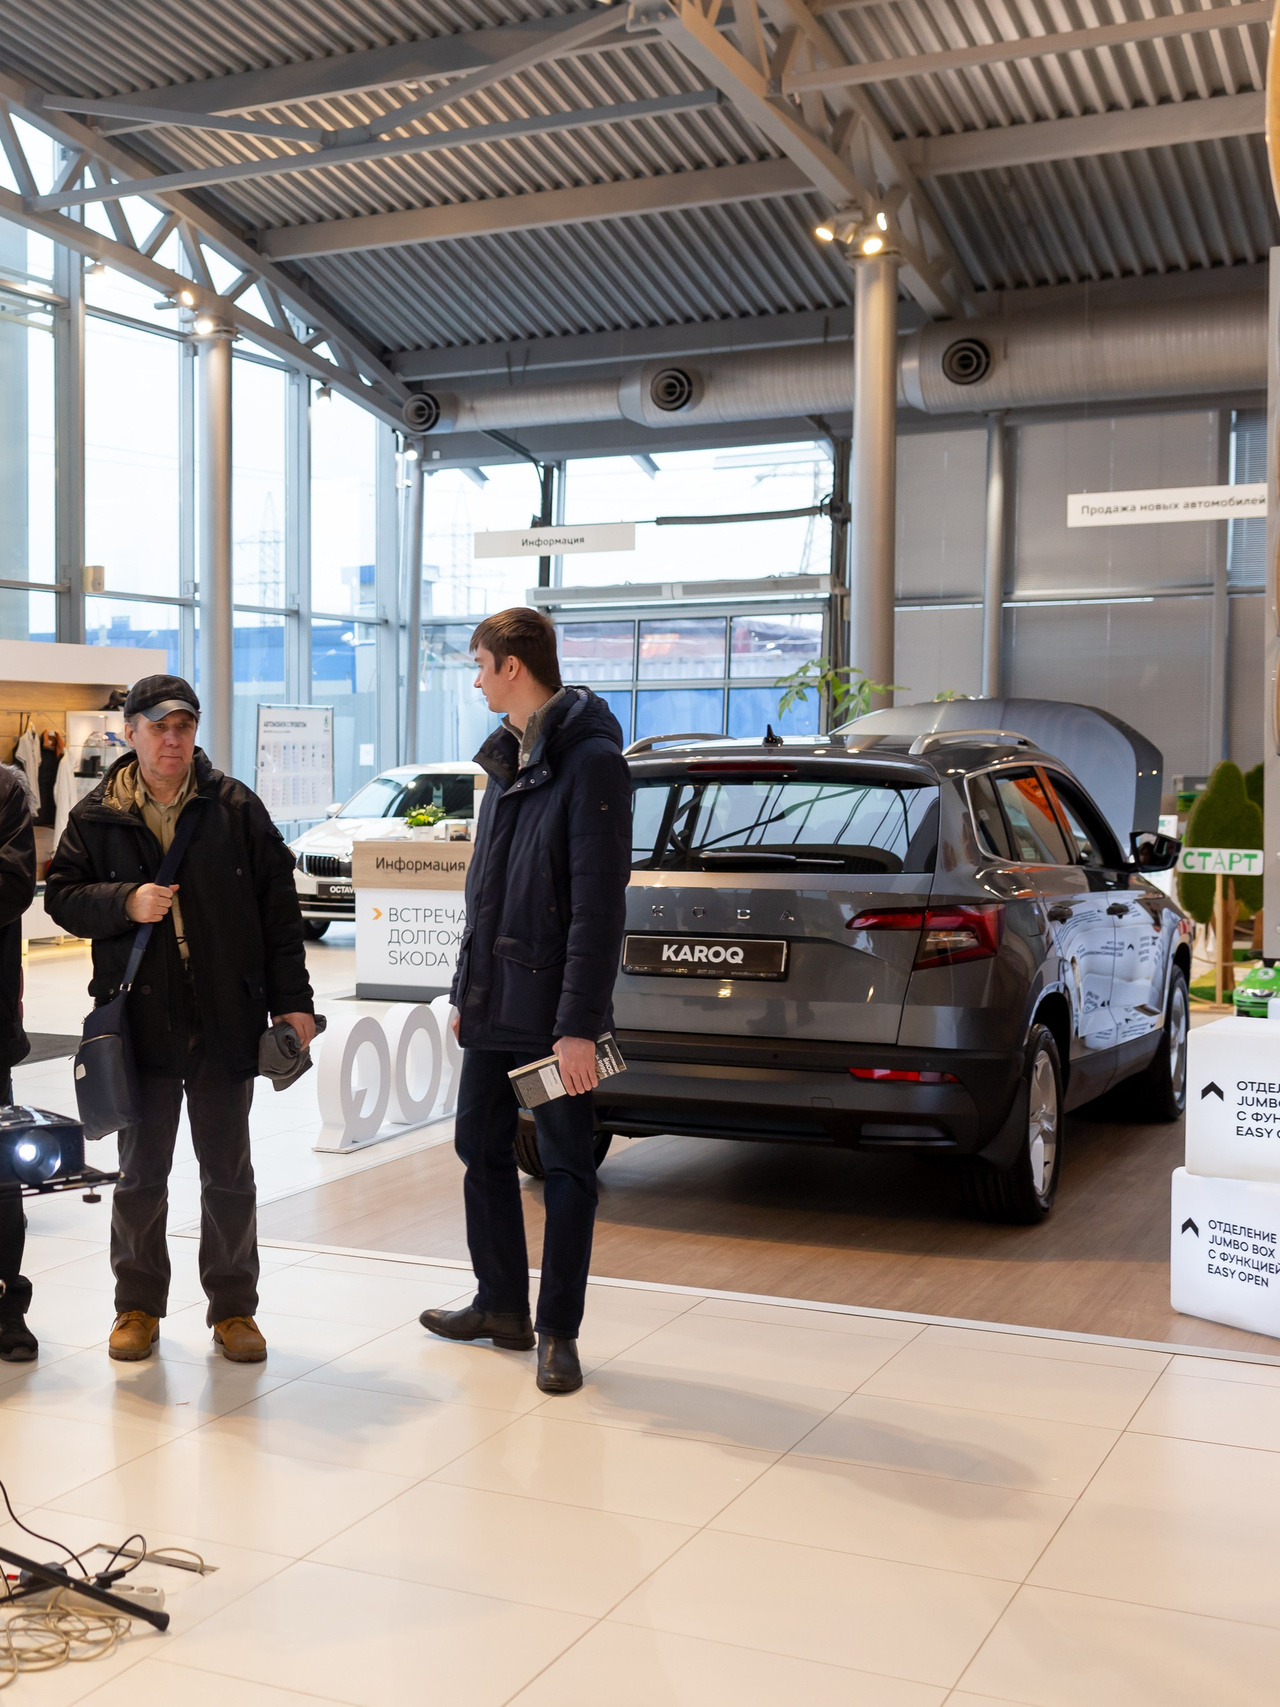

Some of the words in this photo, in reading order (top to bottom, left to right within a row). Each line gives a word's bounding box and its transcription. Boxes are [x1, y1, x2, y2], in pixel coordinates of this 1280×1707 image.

[1081, 505, 1136, 516] Продажа
[1140, 503, 1179, 511] новых
[1183, 495, 1266, 509] автомобилей
[521, 537, 585, 547] Информация
[376, 856, 466, 873] Информация
[1183, 851, 1258, 872] СТАРТ
[388, 907, 466, 924] ВСТРЕЧА
[388, 950, 450, 967] SKODA
[662, 944, 744, 964] KAROQ
[1236, 1096, 1280, 1108] JUMB
[1236, 1111, 1247, 1121] С
[1236, 1126, 1274, 1138] EASY
[1208, 1219, 1277, 1244] ОТДЕЛЕНИЕ
[1208, 1234, 1249, 1252] JUMBO
[1252, 1244, 1275, 1259] BOX
[1208, 1249, 1217, 1259] С
[1207, 1263, 1236, 1279] EASY
[1238, 1271, 1269, 1288] OPEN
